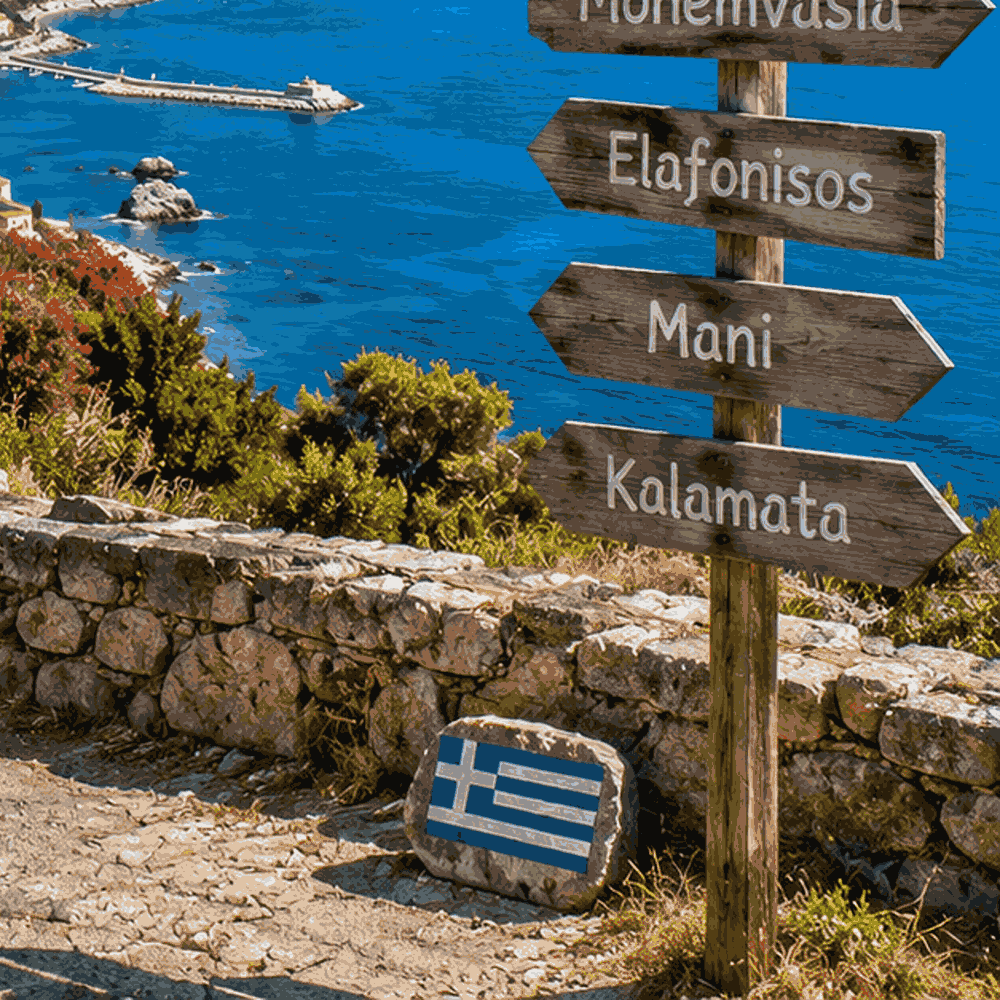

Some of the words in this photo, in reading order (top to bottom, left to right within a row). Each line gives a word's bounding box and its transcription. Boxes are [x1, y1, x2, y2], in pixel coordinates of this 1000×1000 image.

[608, 130, 873, 213] Elafonisos
[648, 300, 771, 369] Mani
[607, 454, 851, 544] Kalamata
